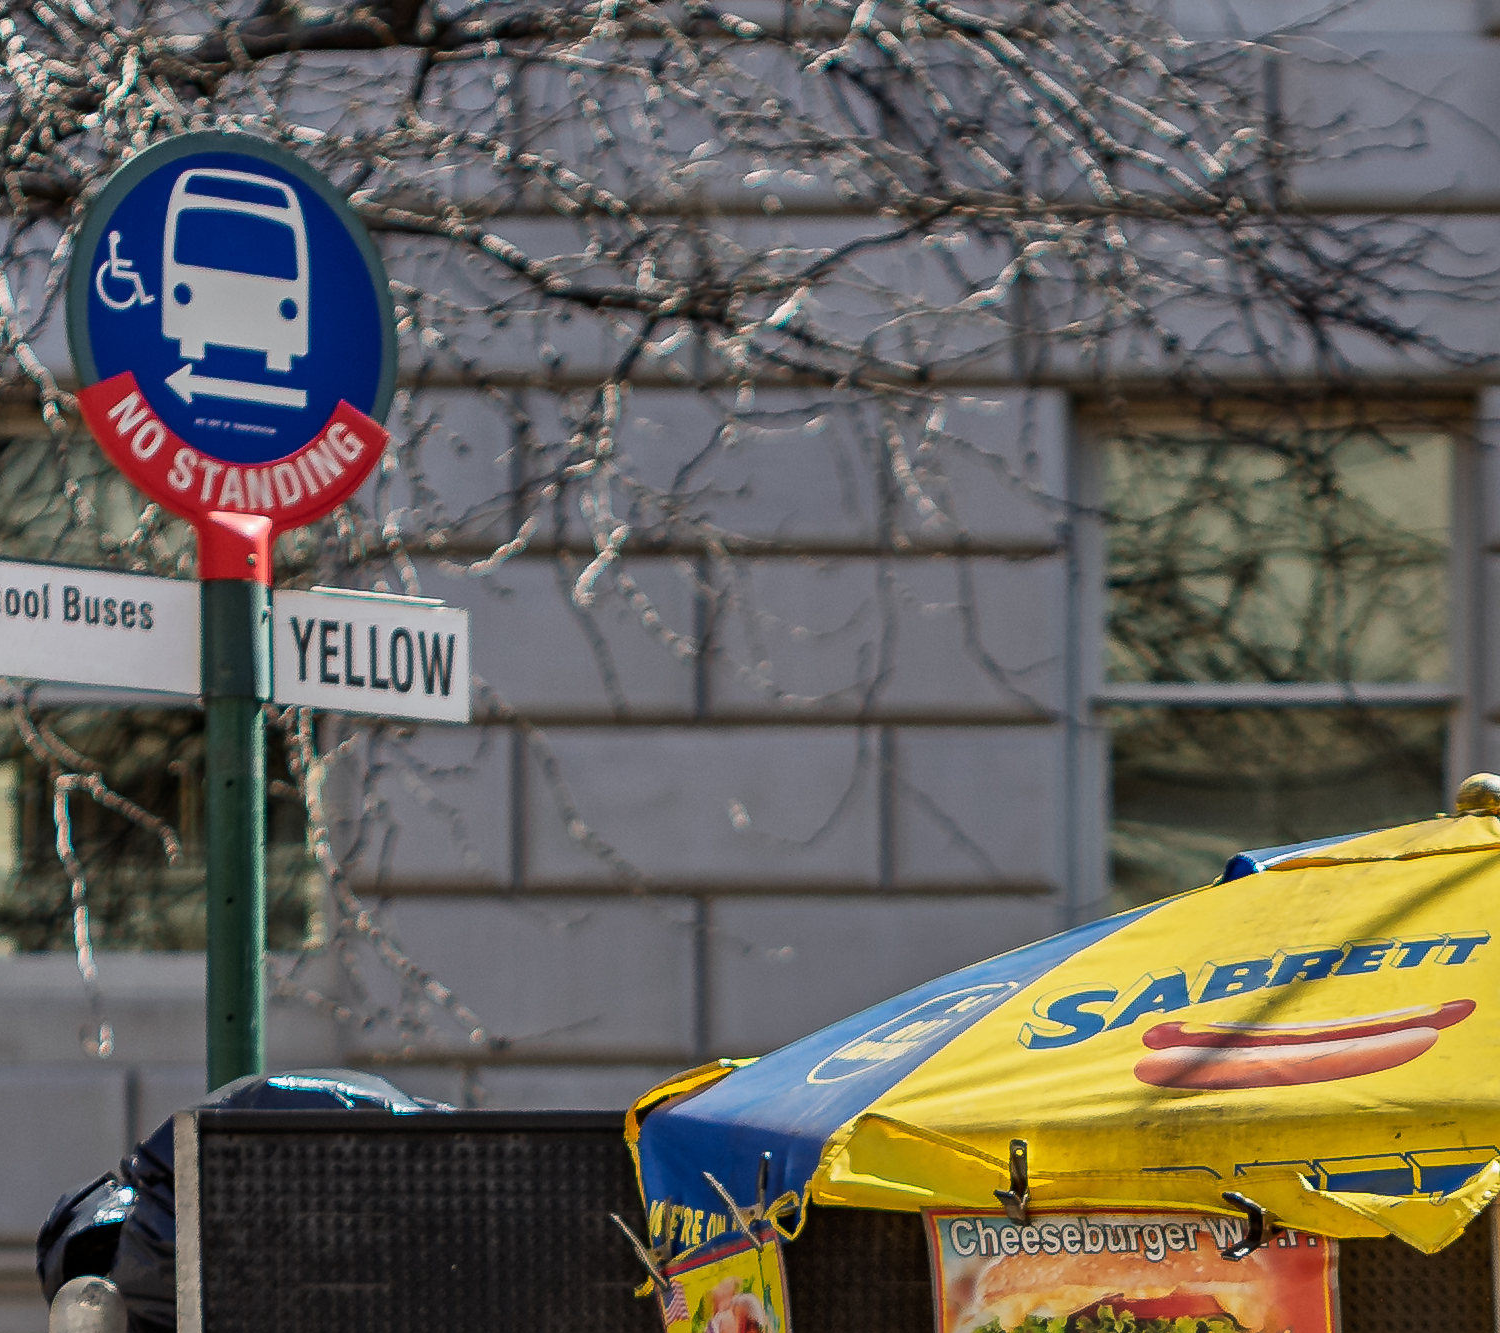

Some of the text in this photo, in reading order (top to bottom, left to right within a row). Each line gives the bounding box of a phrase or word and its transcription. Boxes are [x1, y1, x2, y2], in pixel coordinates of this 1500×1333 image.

[107, 391, 365, 511] NO STANDING
[63, 588, 154, 631] Buses
[290, 617, 456, 697] YELLOW
[1018, 931, 1491, 1050] SABRETT
[949, 1216, 1198, 1262] Cheeseburger
